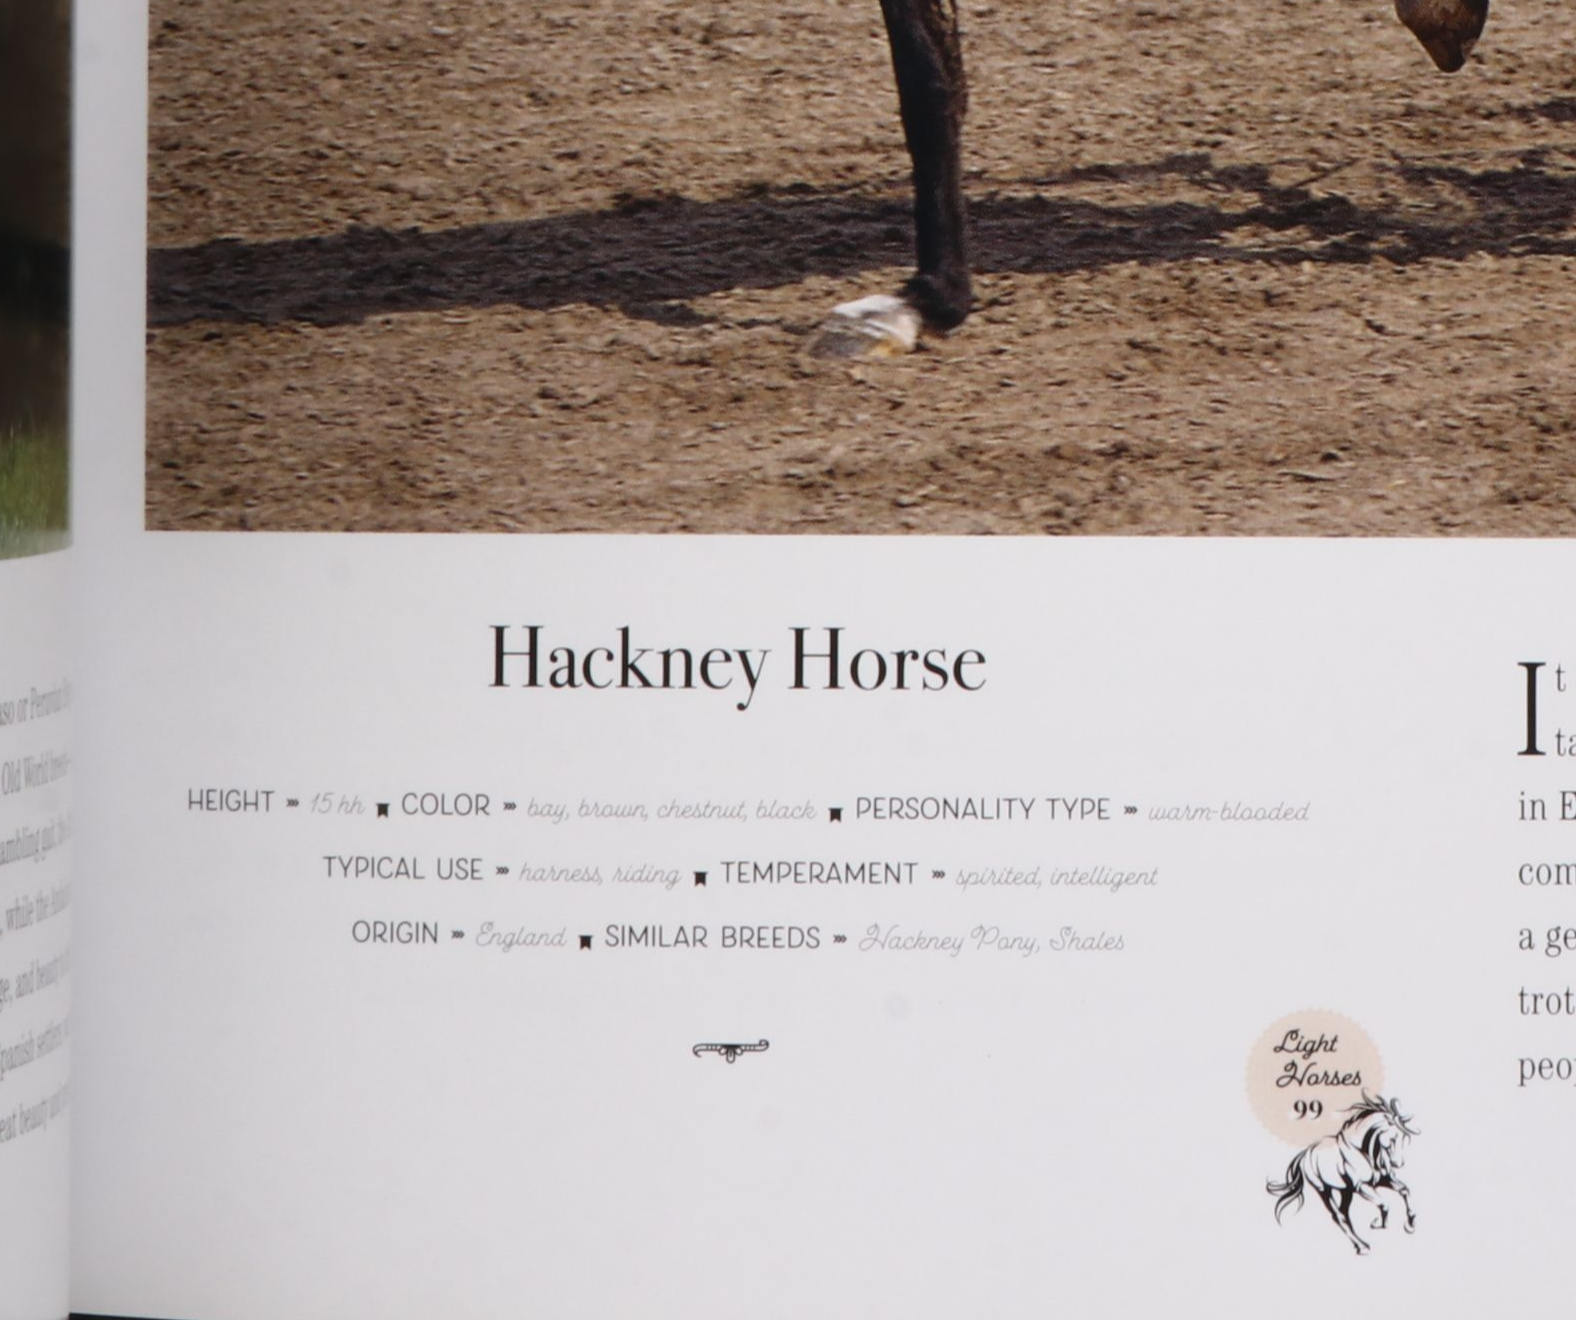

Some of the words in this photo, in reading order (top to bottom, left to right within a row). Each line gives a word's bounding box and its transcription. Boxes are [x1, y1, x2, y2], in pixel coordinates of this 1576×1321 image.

[489, 625, 770, 711] Hackney
[789, 627, 986, 691] Horse
[187, 787, 276, 813] HEIGHT
[308, 790, 336, 816] 15
[336, 793, 367, 817] hh
[400, 791, 492, 817] COLOR
[526, 797, 570, 825] bay,
[577, 798, 649, 822] brown,
[656, 798, 748, 823] chestnut,
[755, 799, 817, 820] black
[855, 795, 1037, 821] PERSONALITY
[1044, 796, 1112, 822] TYPE
[1148, 801, 1311, 822] warm-blooded
[1520, 791, 1546, 820] in
[321, 854, 427, 881] TYPICAL
[436, 856, 485, 882] USE
[518, 861, 604, 886] harness,
[611, 863, 683, 891] riding
[719, 860, 920, 886] TEMPERAMENT
[955, 865, 1043, 892] spirited,
[1049, 865, 1159, 894] intelligent
[351, 919, 439, 945] ORIGIN
[475, 920, 568, 954] England
[604, 923, 709, 949] SIMILAR
[720, 924, 821, 950] BREEDS
[857, 922, 965, 958] Hackney
[970, 923, 1041, 958] Pony,
[1048, 925, 1125, 952] Shales
[1519, 929, 1535, 950] a
[1519, 987, 1574, 1015] trot
[1273, 1029, 1339, 1060] Light
[1276, 1060, 1362, 1088] Horses
[1293, 1099, 1323, 1120] 99
